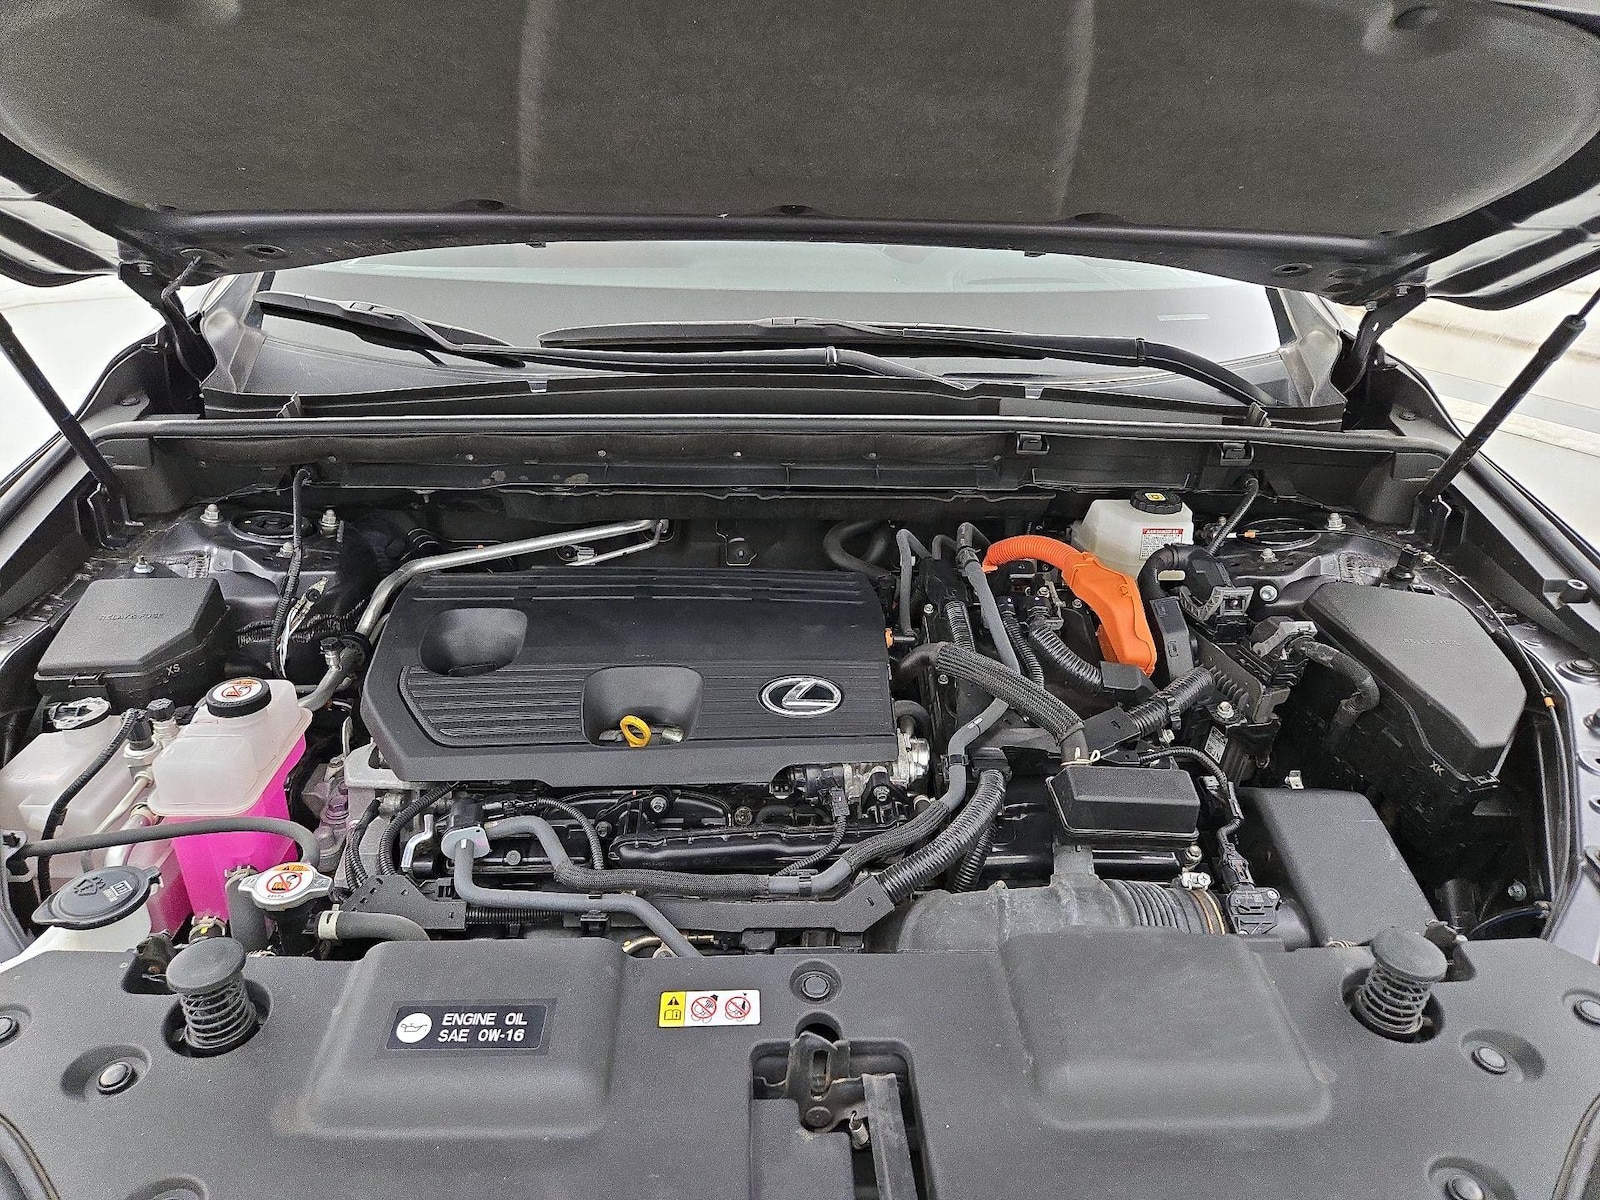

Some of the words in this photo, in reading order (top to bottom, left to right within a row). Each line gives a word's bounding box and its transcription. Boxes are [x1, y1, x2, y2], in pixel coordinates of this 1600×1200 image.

[166, 663, 181, 676] XS
[1429, 760, 1445, 777] XK
[441, 1012, 497, 1026] ENGINE
[504, 1012, 528, 1026] OIL
[437, 1028, 470, 1042] SAE
[477, 1028, 525, 1042] 0W-16
